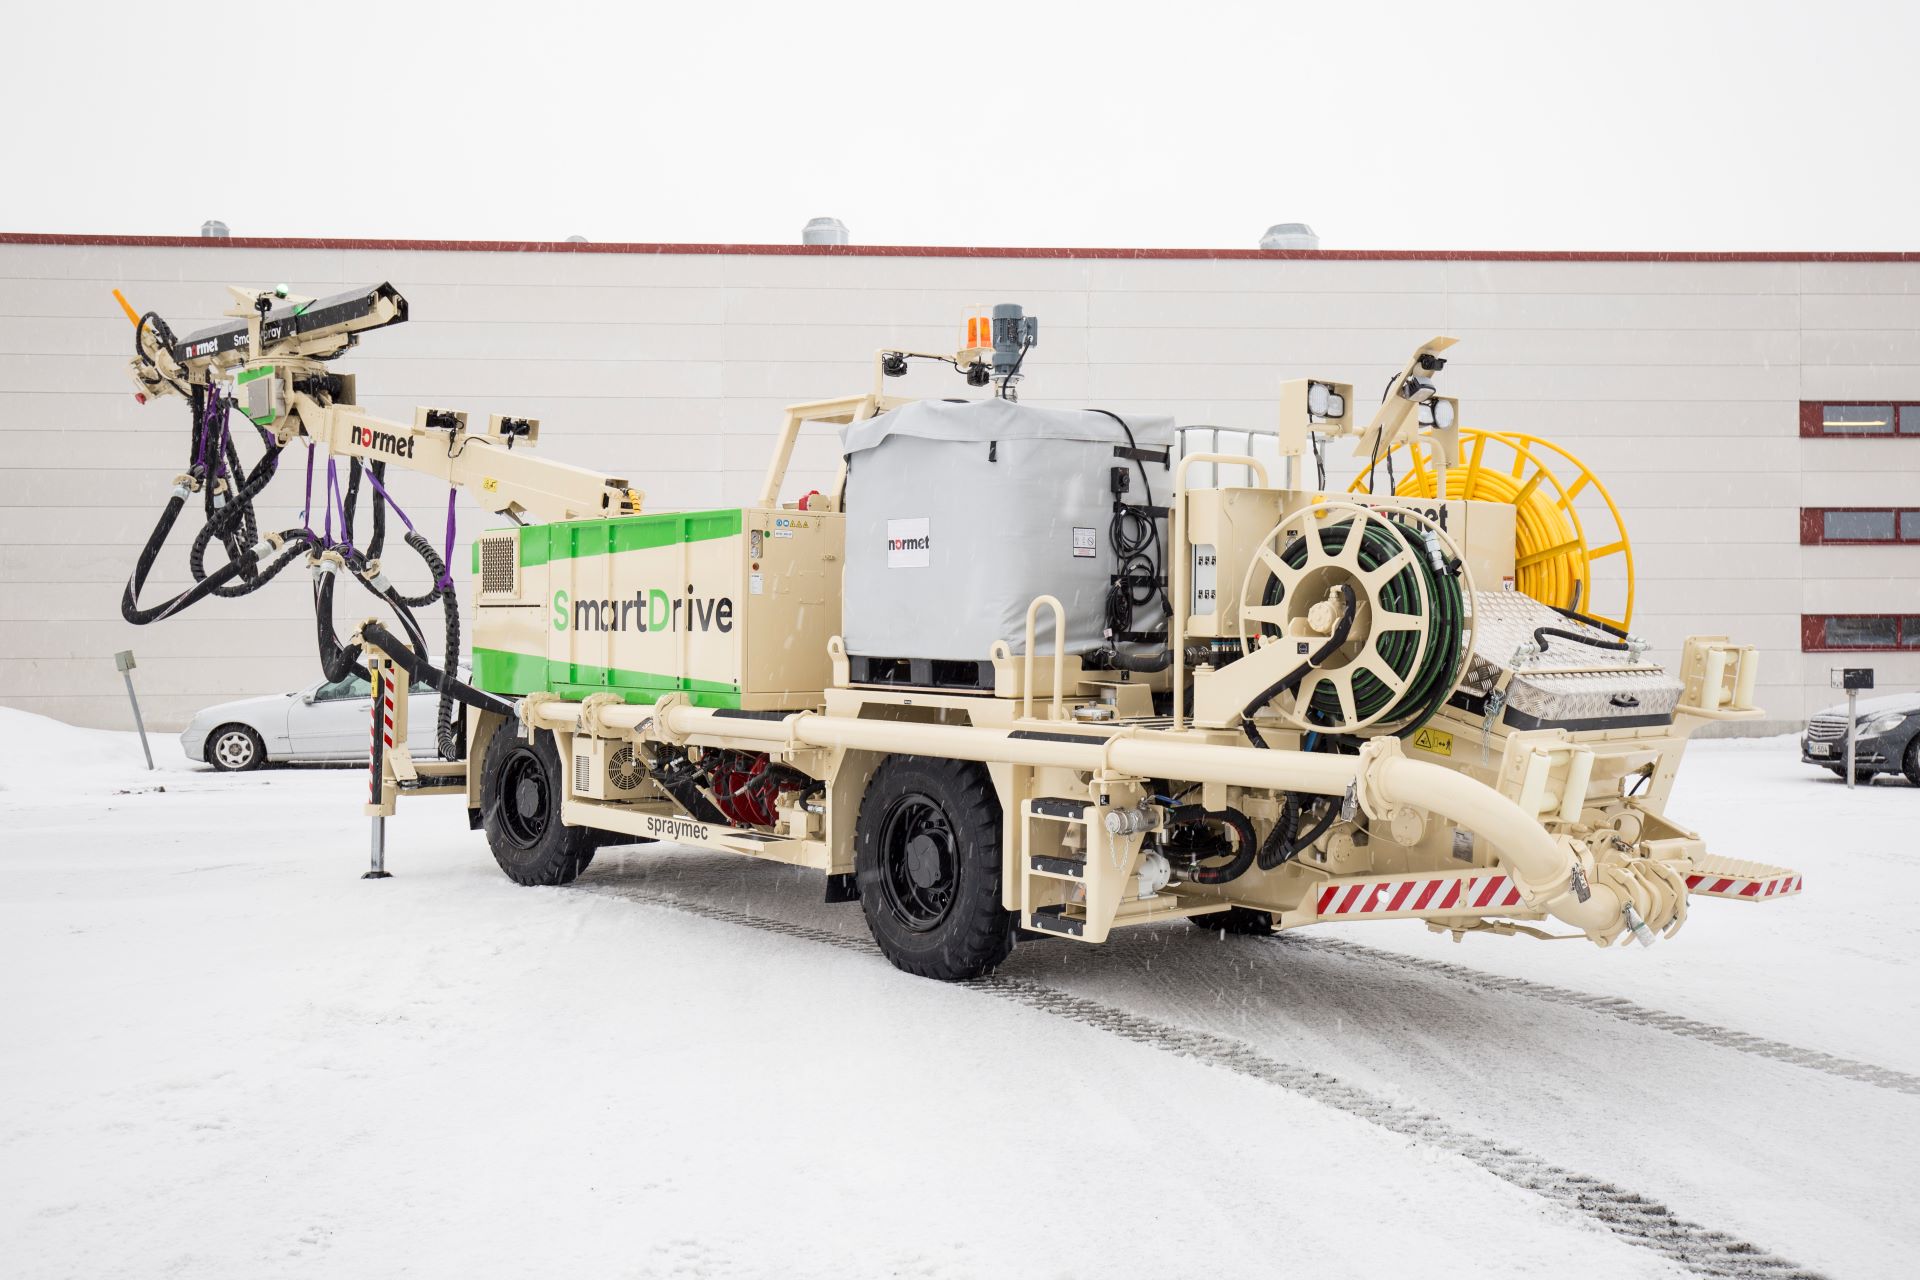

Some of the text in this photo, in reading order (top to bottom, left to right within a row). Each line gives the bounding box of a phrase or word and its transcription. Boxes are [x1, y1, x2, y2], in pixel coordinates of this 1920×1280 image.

[185, 337, 219, 358] normet
[351, 425, 415, 459] normet
[888, 534, 930, 551] normet
[552, 583, 733, 633] SmartDrive
[647, 816, 709, 840] spraymec
